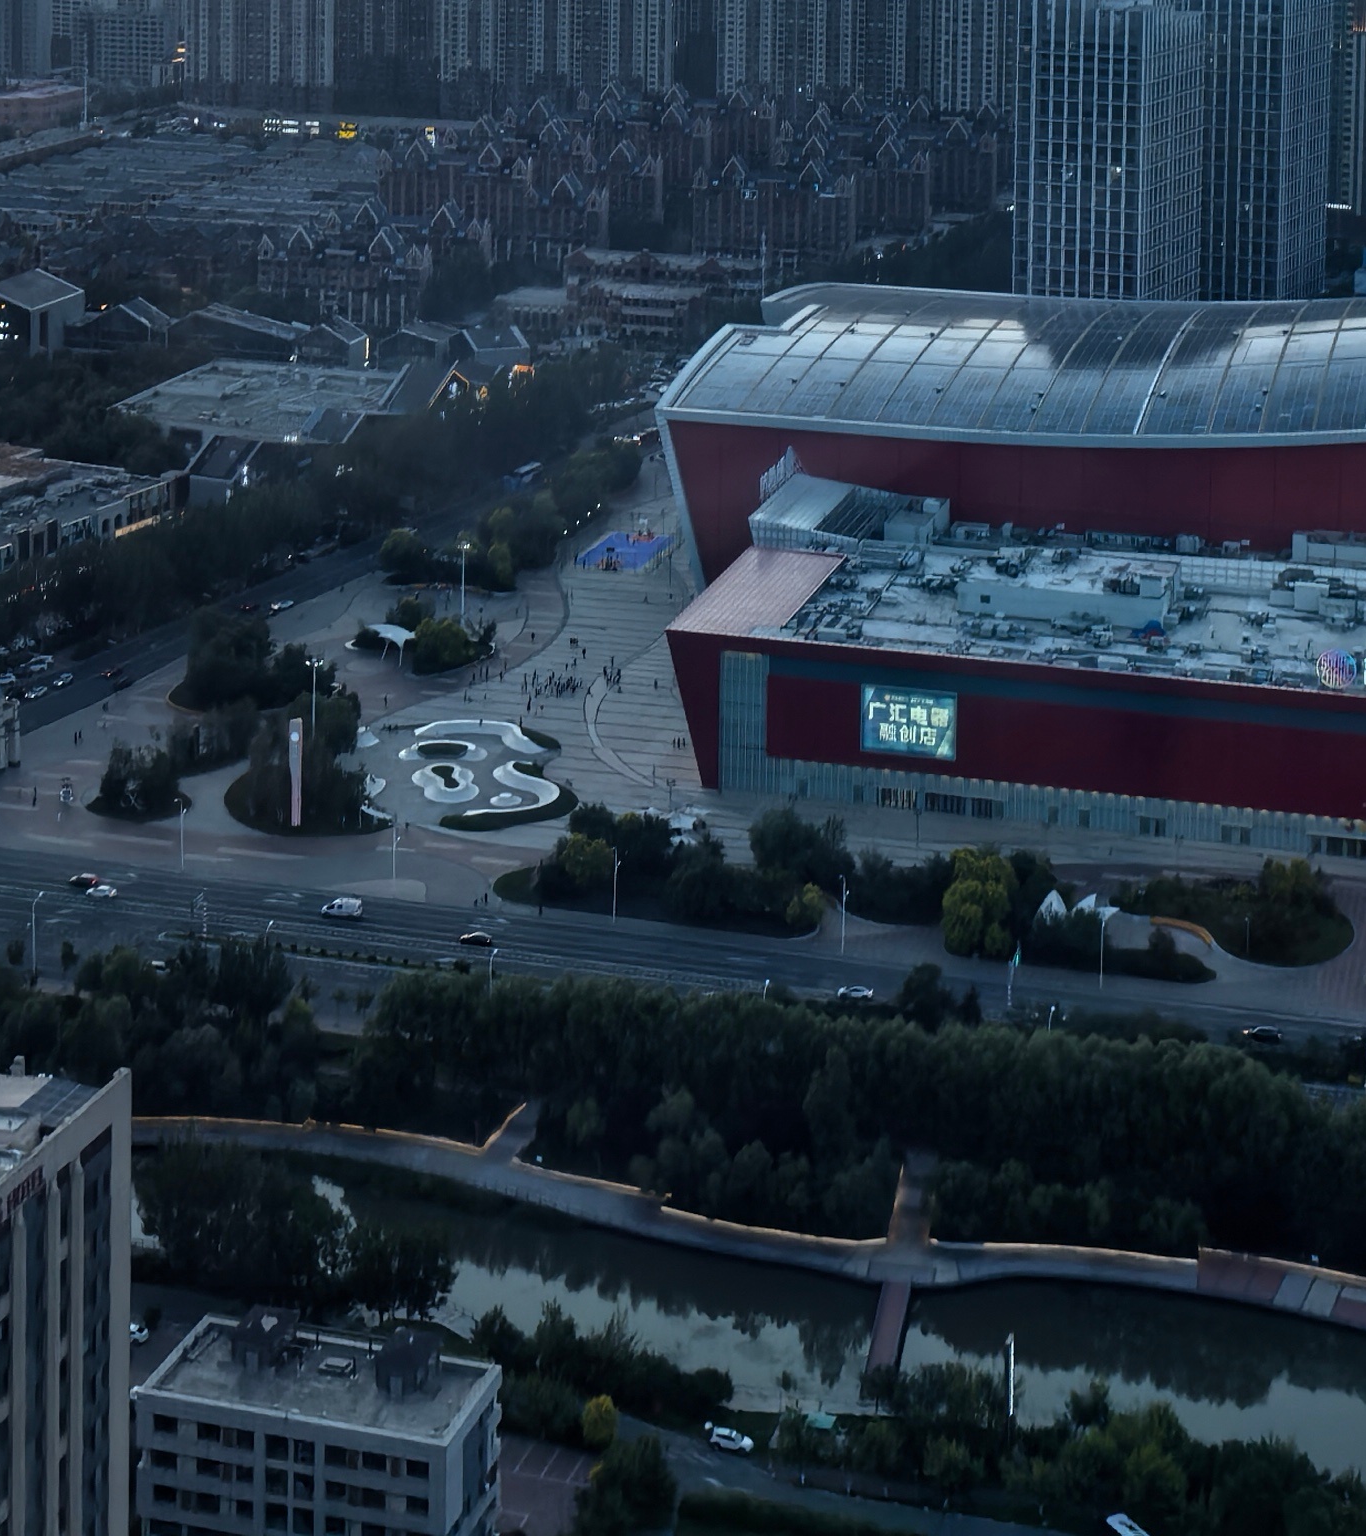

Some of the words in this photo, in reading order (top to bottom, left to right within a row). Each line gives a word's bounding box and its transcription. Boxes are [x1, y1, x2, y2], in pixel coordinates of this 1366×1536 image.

[868, 701, 949, 727] 广汇电器
[879, 722, 937, 746] 融创店
